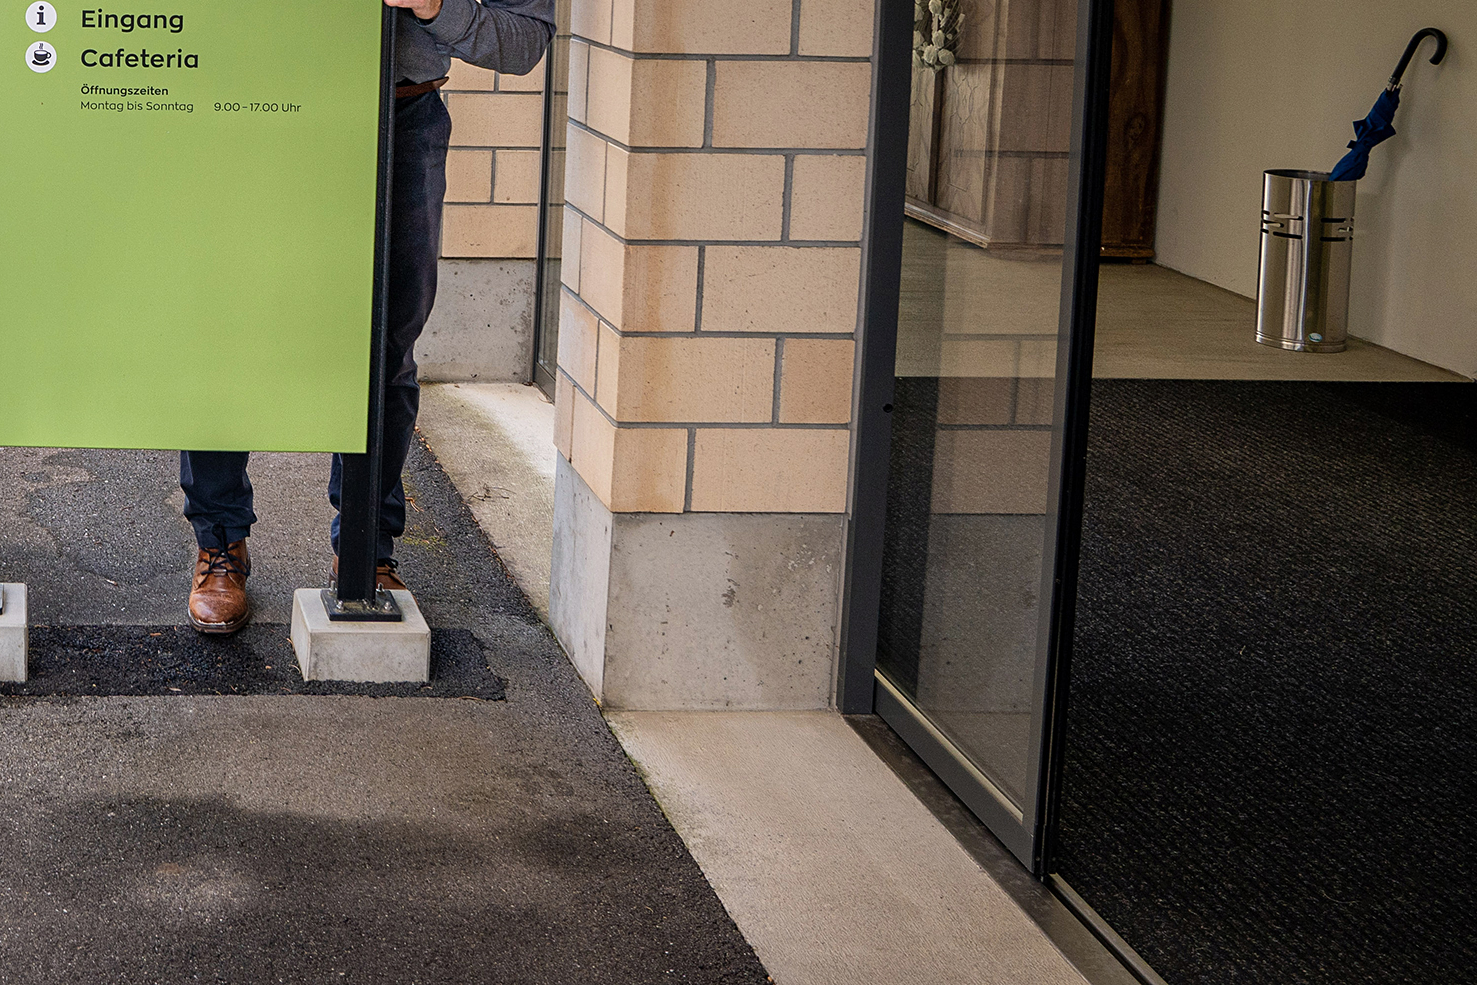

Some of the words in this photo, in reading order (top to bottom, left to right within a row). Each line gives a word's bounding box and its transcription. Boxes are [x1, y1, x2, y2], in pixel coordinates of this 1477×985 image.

[81, 8, 184, 34] Eingang
[80, 48, 200, 69] Cafeteria
[80, 84, 169, 97] Öffnungszeiten
[80, 100, 124, 113] Montag
[126, 101, 143, 111] bis
[145, 101, 194, 113] Sonntag
[281, 103, 302, 113] Uhr
